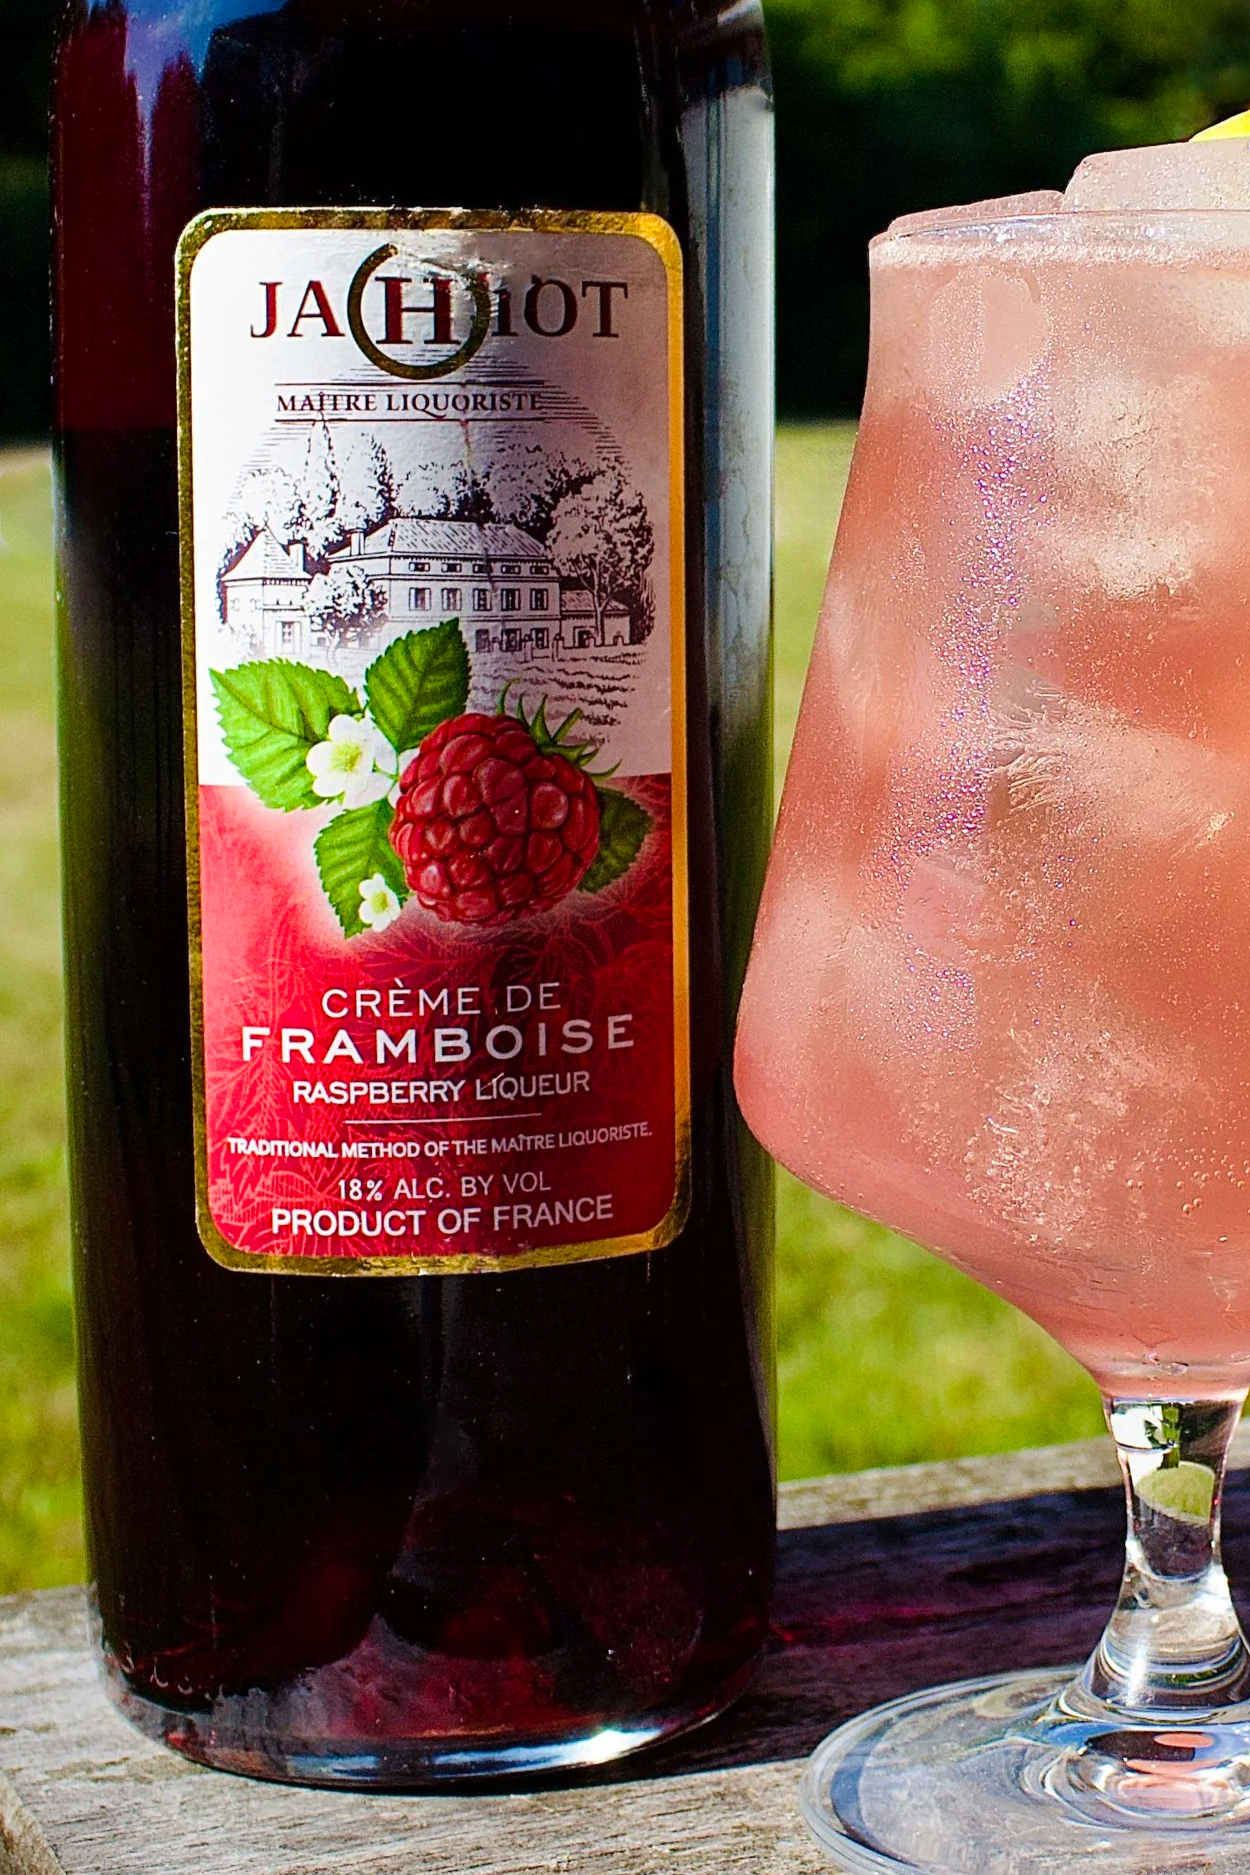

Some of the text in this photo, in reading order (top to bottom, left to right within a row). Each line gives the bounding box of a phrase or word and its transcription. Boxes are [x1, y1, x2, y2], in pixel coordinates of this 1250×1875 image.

[386, 392, 542, 420] LIQUORISTE
[321, 977, 562, 1018] CRÈME DE
[241, 1013, 635, 1065] FRAMBOISE
[292, 1071, 591, 1105] RASPBERRY LIQUEUR
[227, 1121, 653, 1159] TRADITIONAL METHOD OF THE MAÎTRE LIQUORISTE.
[337, 1170, 552, 1201] 18% ALC. BY VOL
[271, 1193, 614, 1237] PRODUCT OF FRANCE
